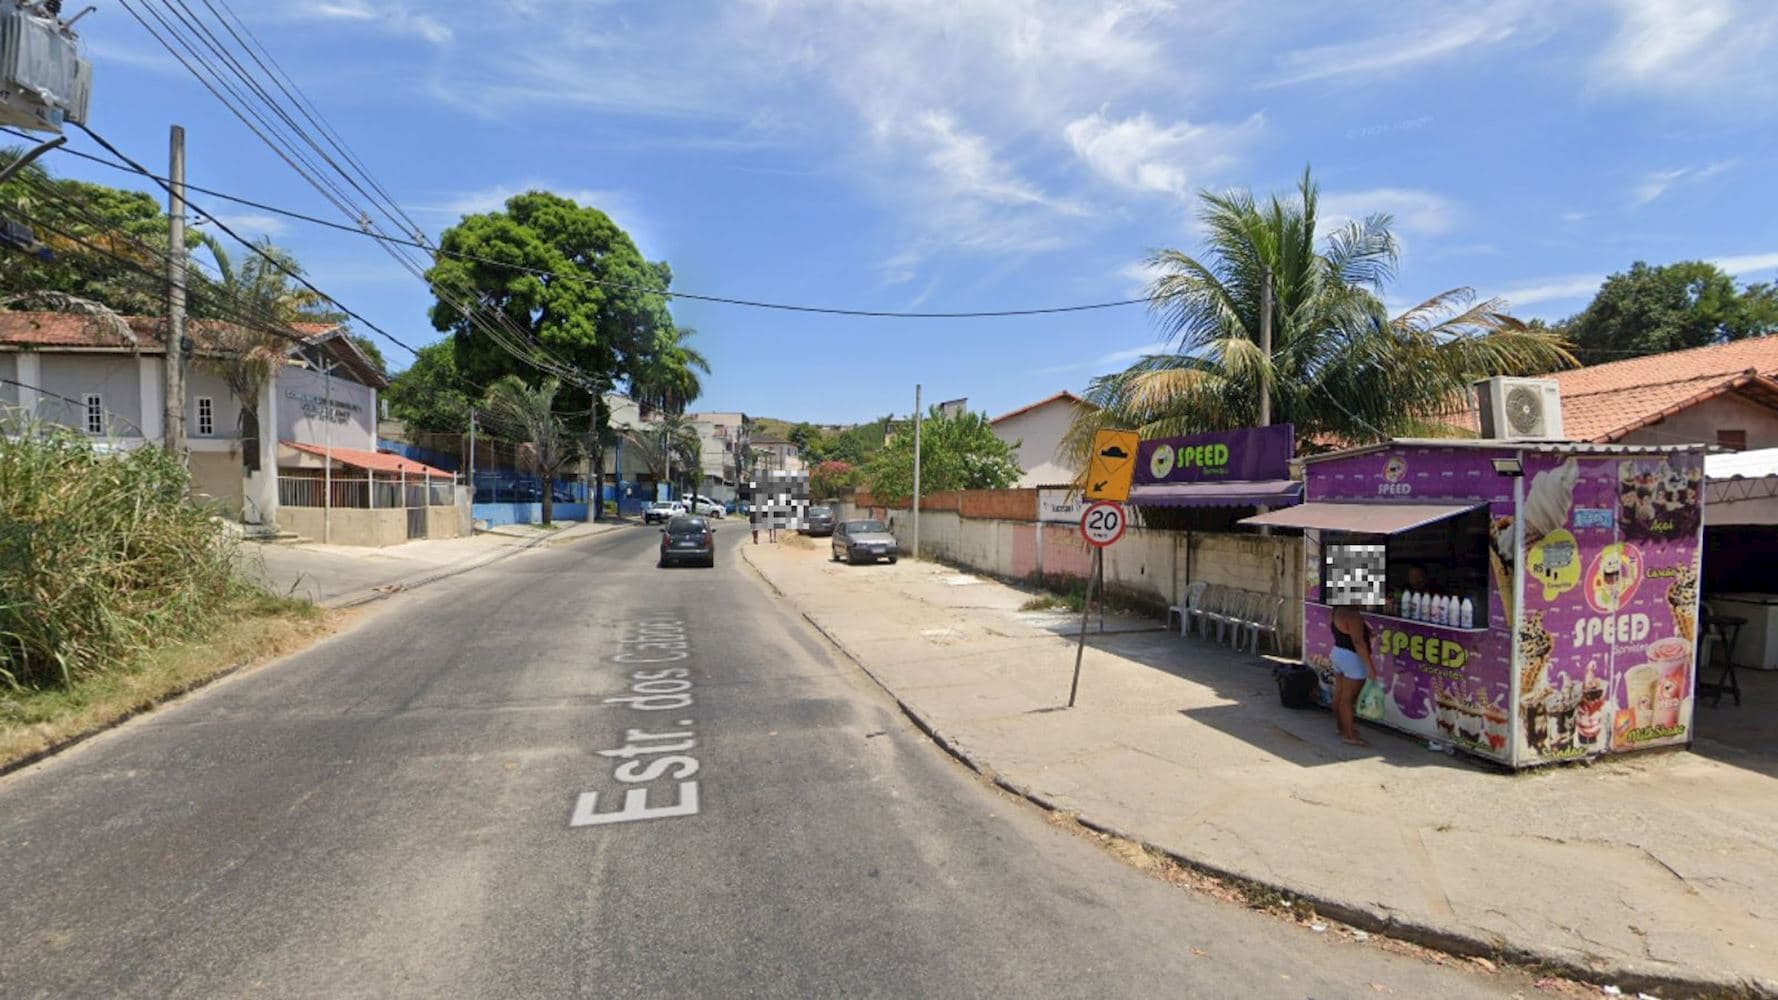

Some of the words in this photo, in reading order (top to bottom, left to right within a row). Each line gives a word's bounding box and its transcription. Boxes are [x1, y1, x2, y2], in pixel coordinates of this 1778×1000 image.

[1177, 444, 1229, 468] SPEED
[1378, 483, 1412, 494] SPEED
[1089, 510, 1118, 531] 20
[1573, 613, 1650, 648] SPEED
[1380, 629, 1467, 669] SPEED
